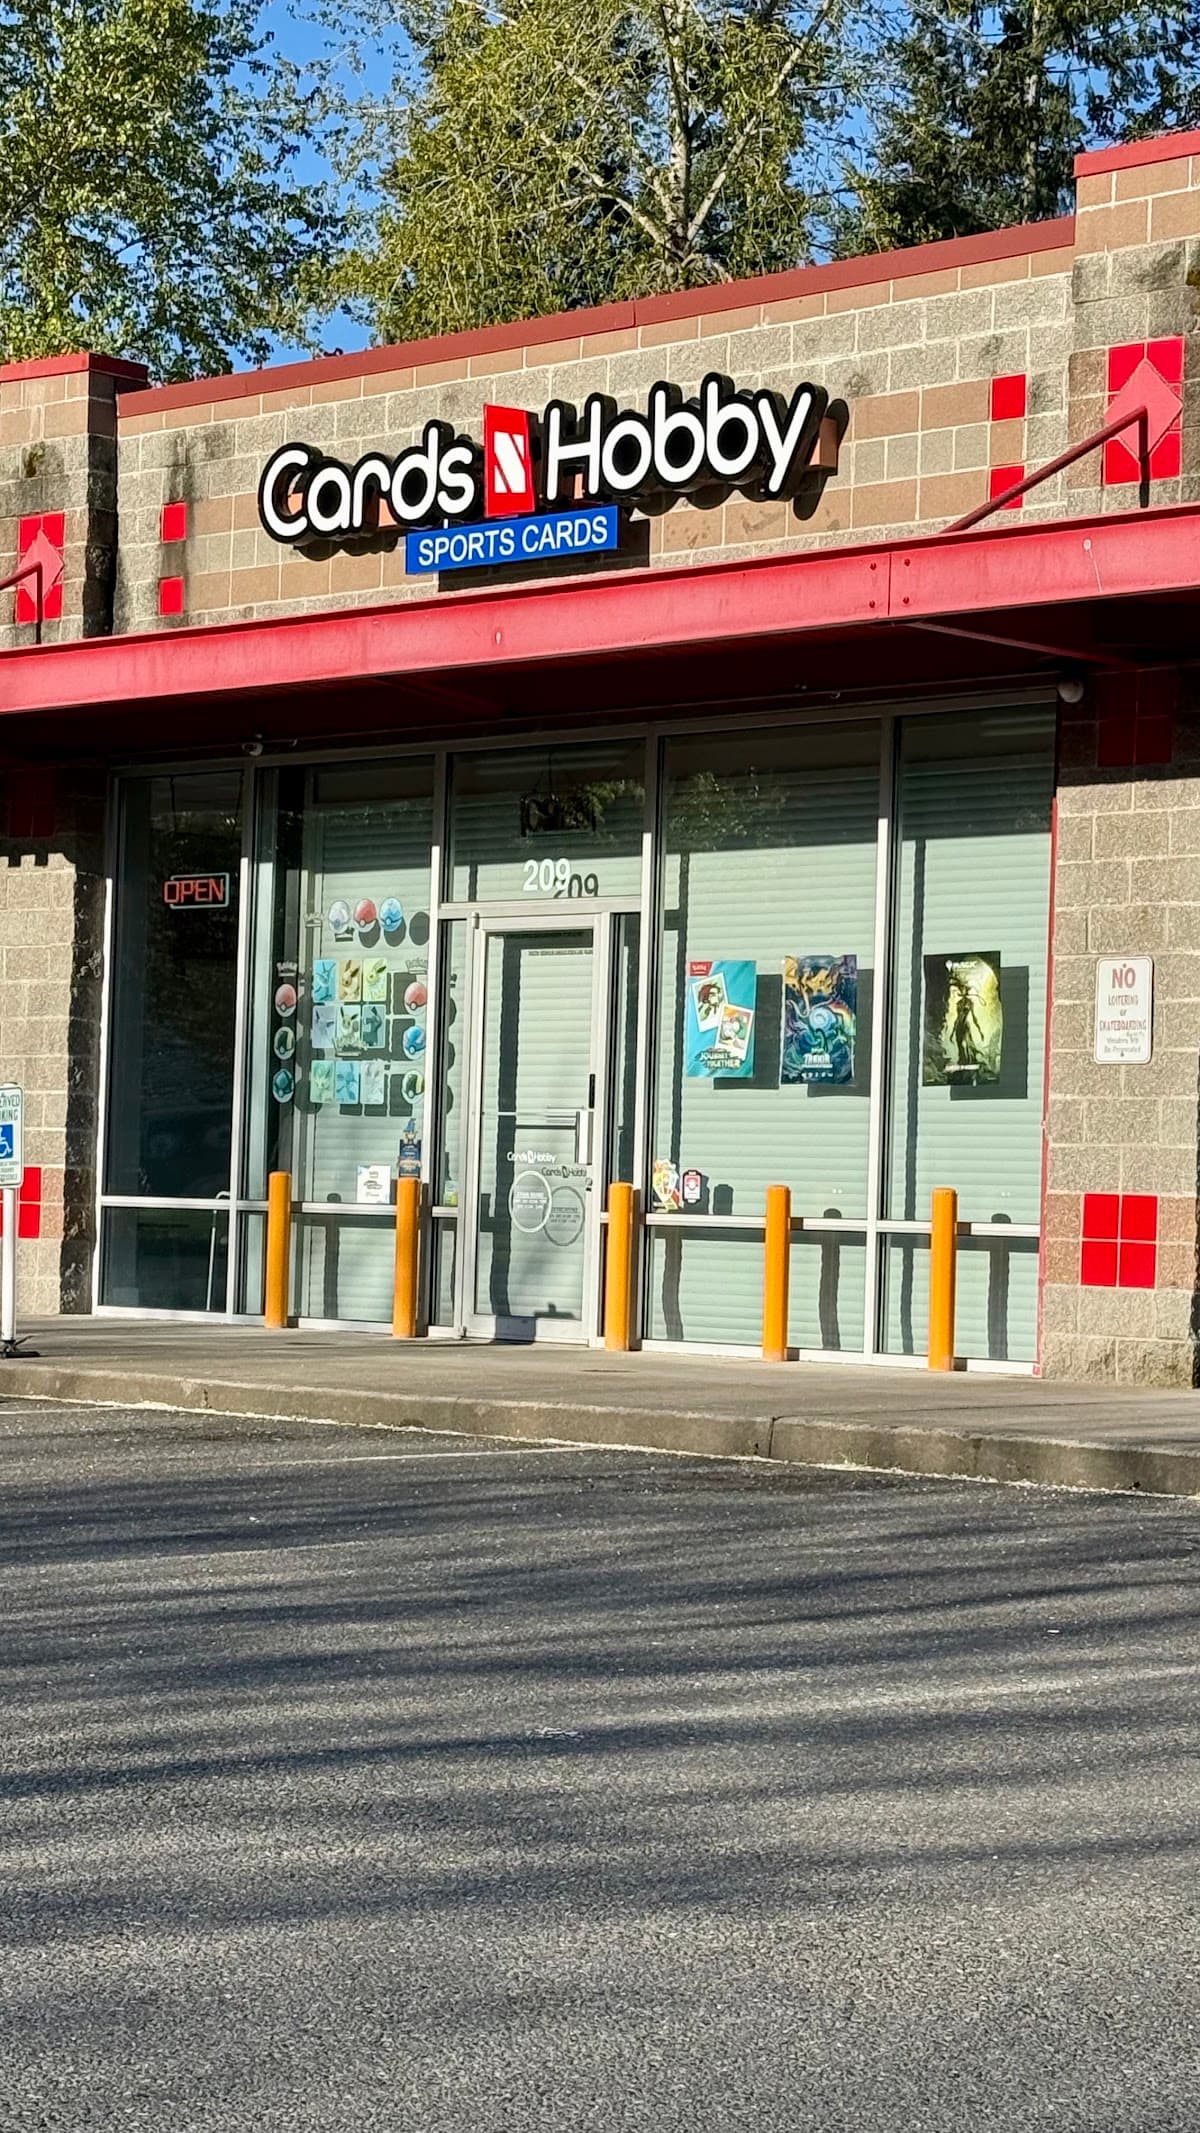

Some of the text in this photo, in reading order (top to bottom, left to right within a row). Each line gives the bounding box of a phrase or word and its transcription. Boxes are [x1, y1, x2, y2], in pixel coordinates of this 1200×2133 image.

[262, 426, 476, 538] Cards
[546, 381, 812, 501] Hobby
[417, 515, 609, 567] SPORTS CARDS
[163, 877, 226, 905] OPEN
[522, 857, 571, 892] 209
[1111, 967, 1136, 989] NO
